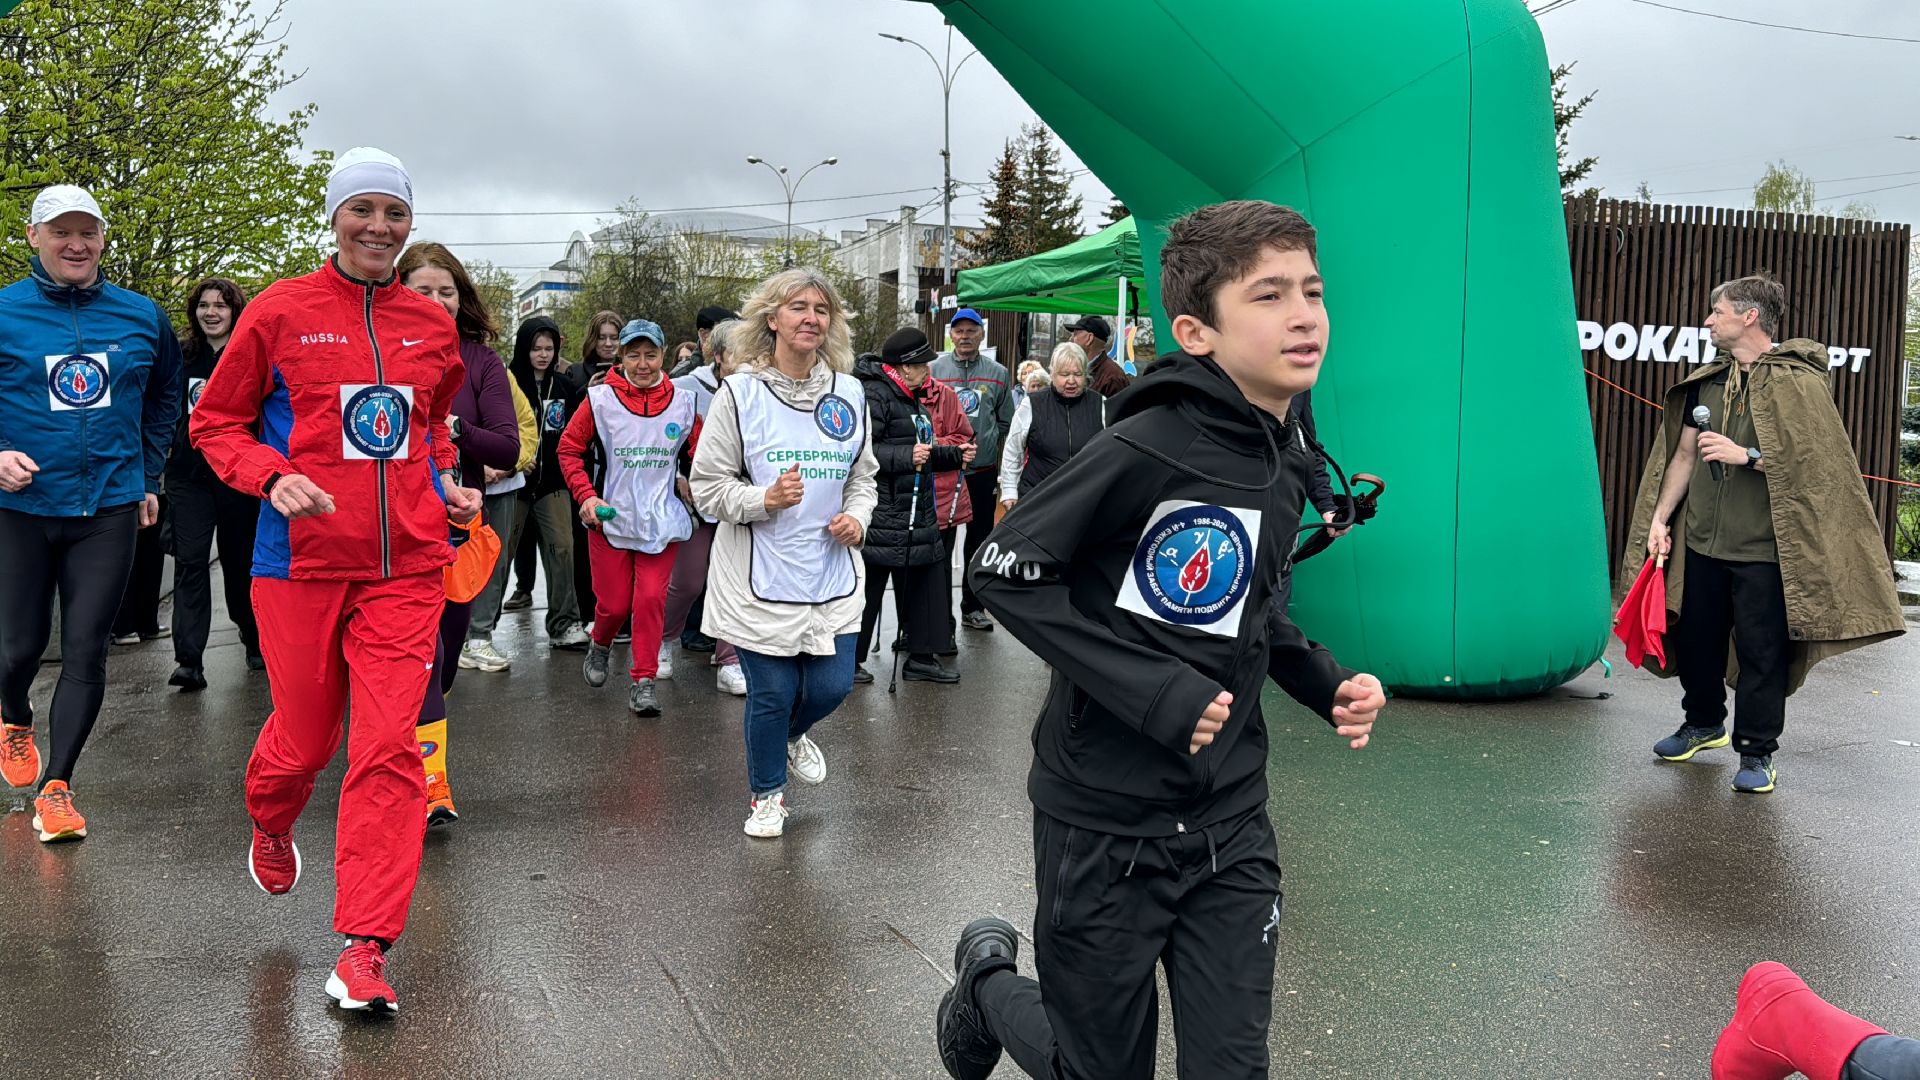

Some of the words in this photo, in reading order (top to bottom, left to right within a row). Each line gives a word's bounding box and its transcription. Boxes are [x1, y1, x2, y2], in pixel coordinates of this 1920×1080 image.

[300, 332, 349, 346] RUSSIA
[613, 446, 677, 457] СЕРЕБРЯНЫЙ
[767, 450, 853, 464] СЕРЕБРЯНЫЙ
[623, 459, 670, 469] ВОЛОНТЕР
[1193, 517, 1228, 531] 1986-2024
[1145, 528, 1173, 571] ЕЖЕГОДНЫЙ
[1146, 572, 1163, 598] ЗАБЕГ
[1160, 597, 1193, 614] ПАМЯТИ
[1194, 595, 1232, 614] ПОДВИГА
